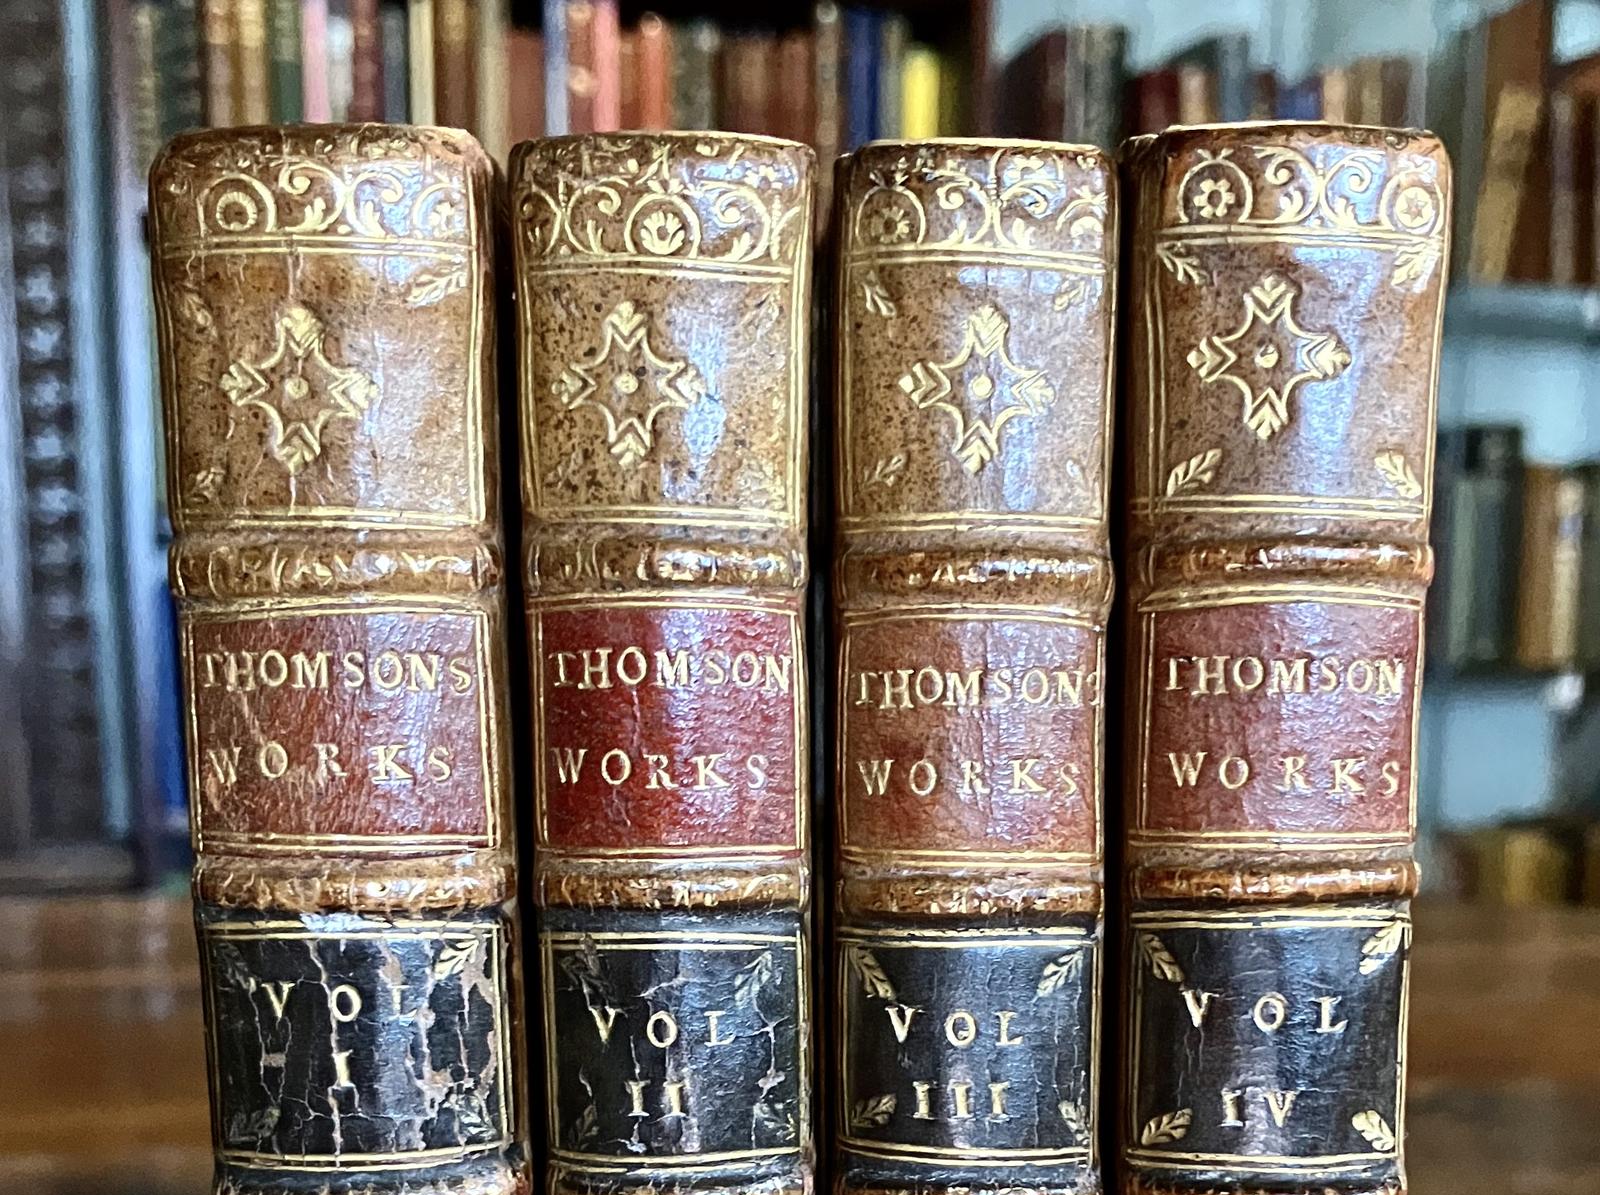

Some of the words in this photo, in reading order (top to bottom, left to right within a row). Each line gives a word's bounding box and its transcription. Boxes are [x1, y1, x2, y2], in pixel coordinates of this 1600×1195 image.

[203, 649, 473, 693] THOMSONS
[548, 646, 793, 694] THOMSON
[1165, 655, 1404, 697] THOMSON
[207, 741, 453, 784] WORKS
[552, 747, 770, 789] WORKS
[857, 757, 1080, 799] WORKS
[1167, 752, 1400, 798] WORKS
[588, 1004, 738, 1048] VOL
[884, 1004, 1025, 1049] VOL
[1181, 989, 1349, 1034] VOL
[330, 1049, 354, 1089] I
[624, 1079, 688, 1118] II
[912, 1080, 1011, 1122] III
[1218, 1087, 1298, 1129] IV
